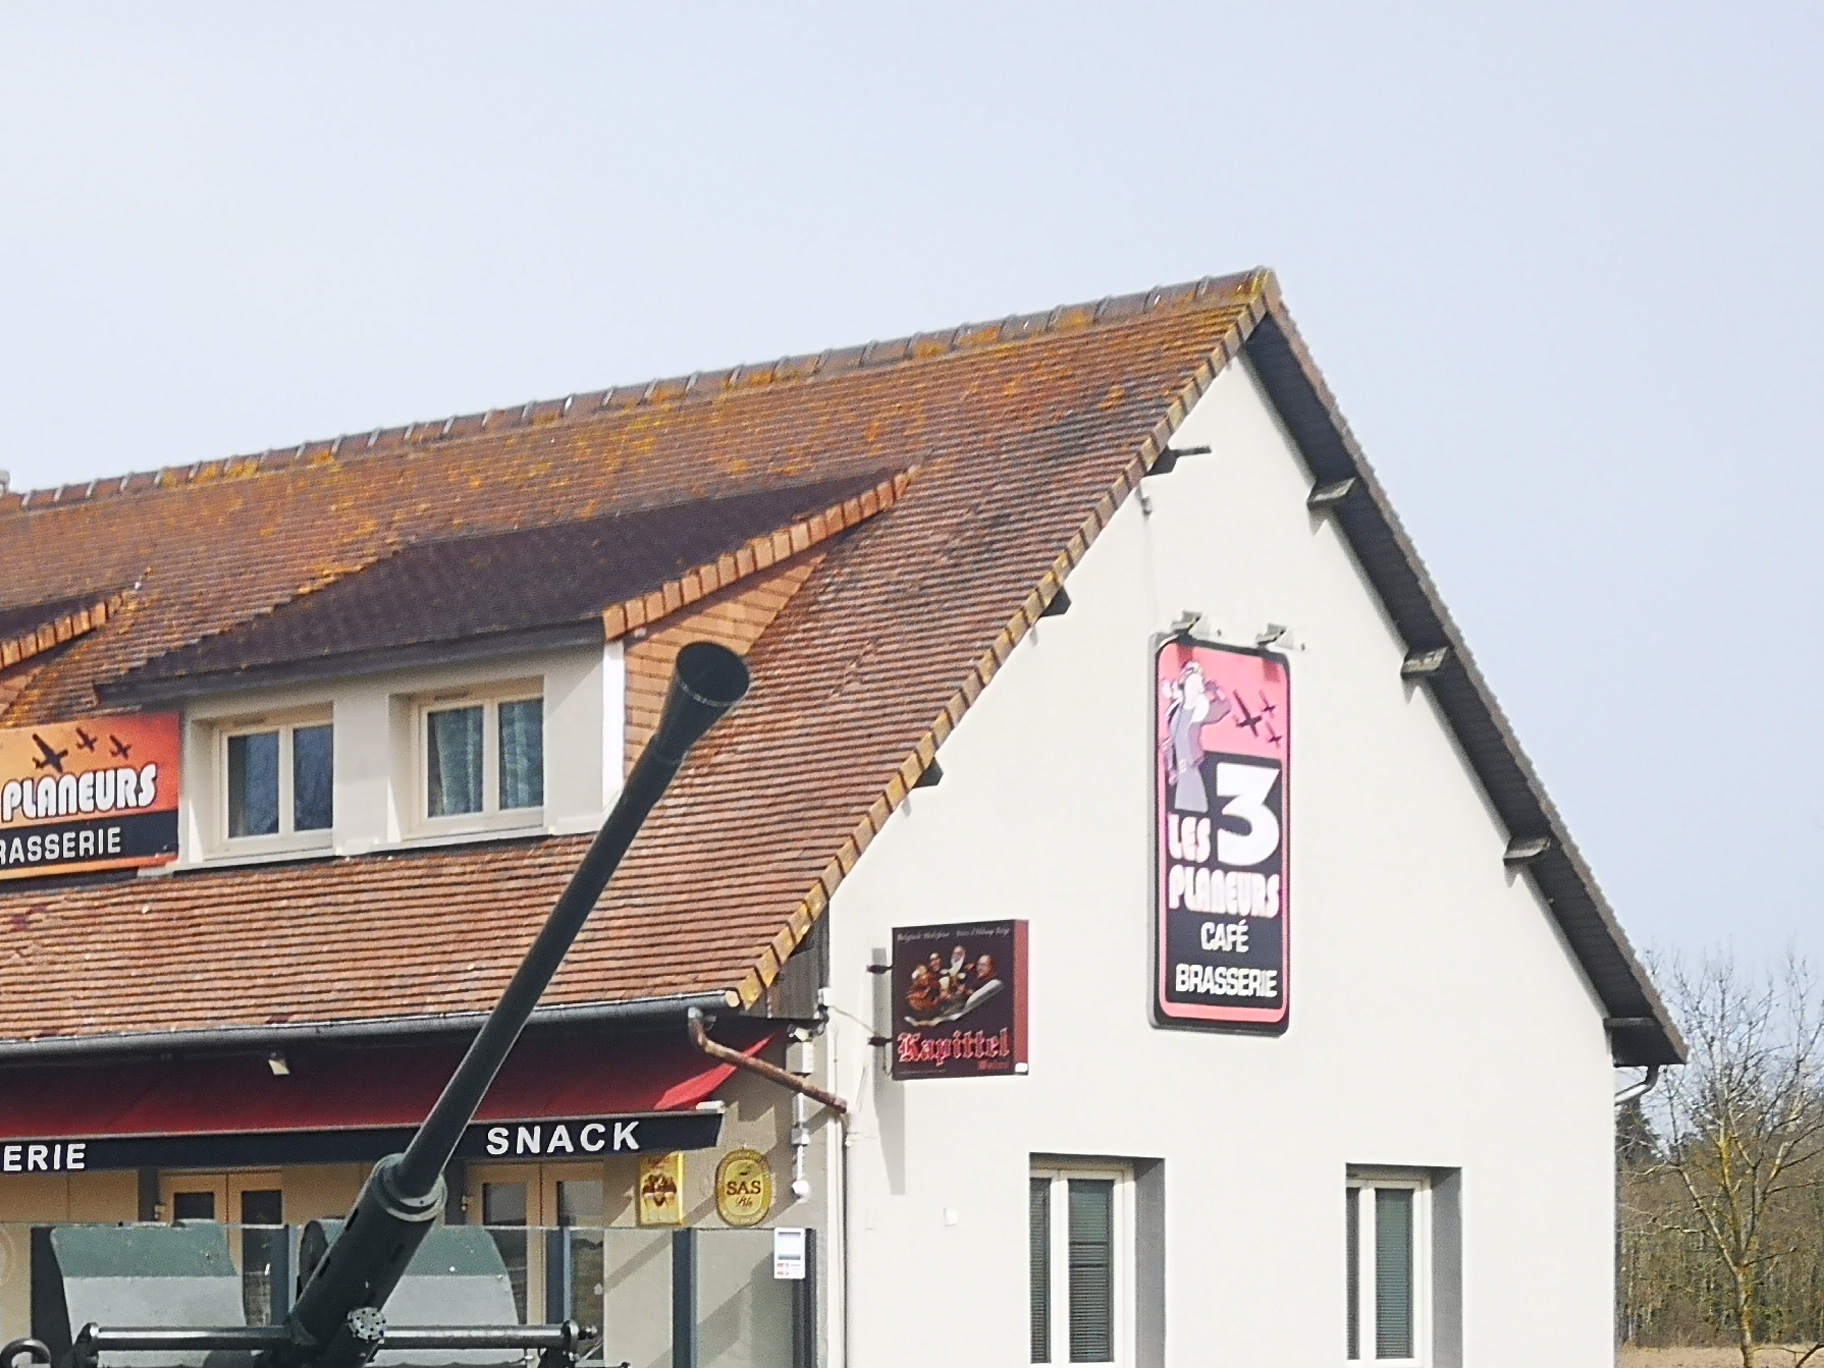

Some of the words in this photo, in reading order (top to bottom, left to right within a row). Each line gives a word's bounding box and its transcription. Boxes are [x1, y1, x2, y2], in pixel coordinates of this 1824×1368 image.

[1, 763, 158, 822] PLANEURS
[1216, 762, 1280, 866] 3
[1168, 814, 1210, 863] LES
[1168, 864, 1280, 918] PLANEURS
[1200, 919, 1249, 953] CAFÉ
[1175, 963, 1278, 998] BRASSERIE
[897, 1027, 1011, 1067] Kapittel
[486, 1121, 641, 1155] SNACK
[726, 1180, 761, 1196] SAS
